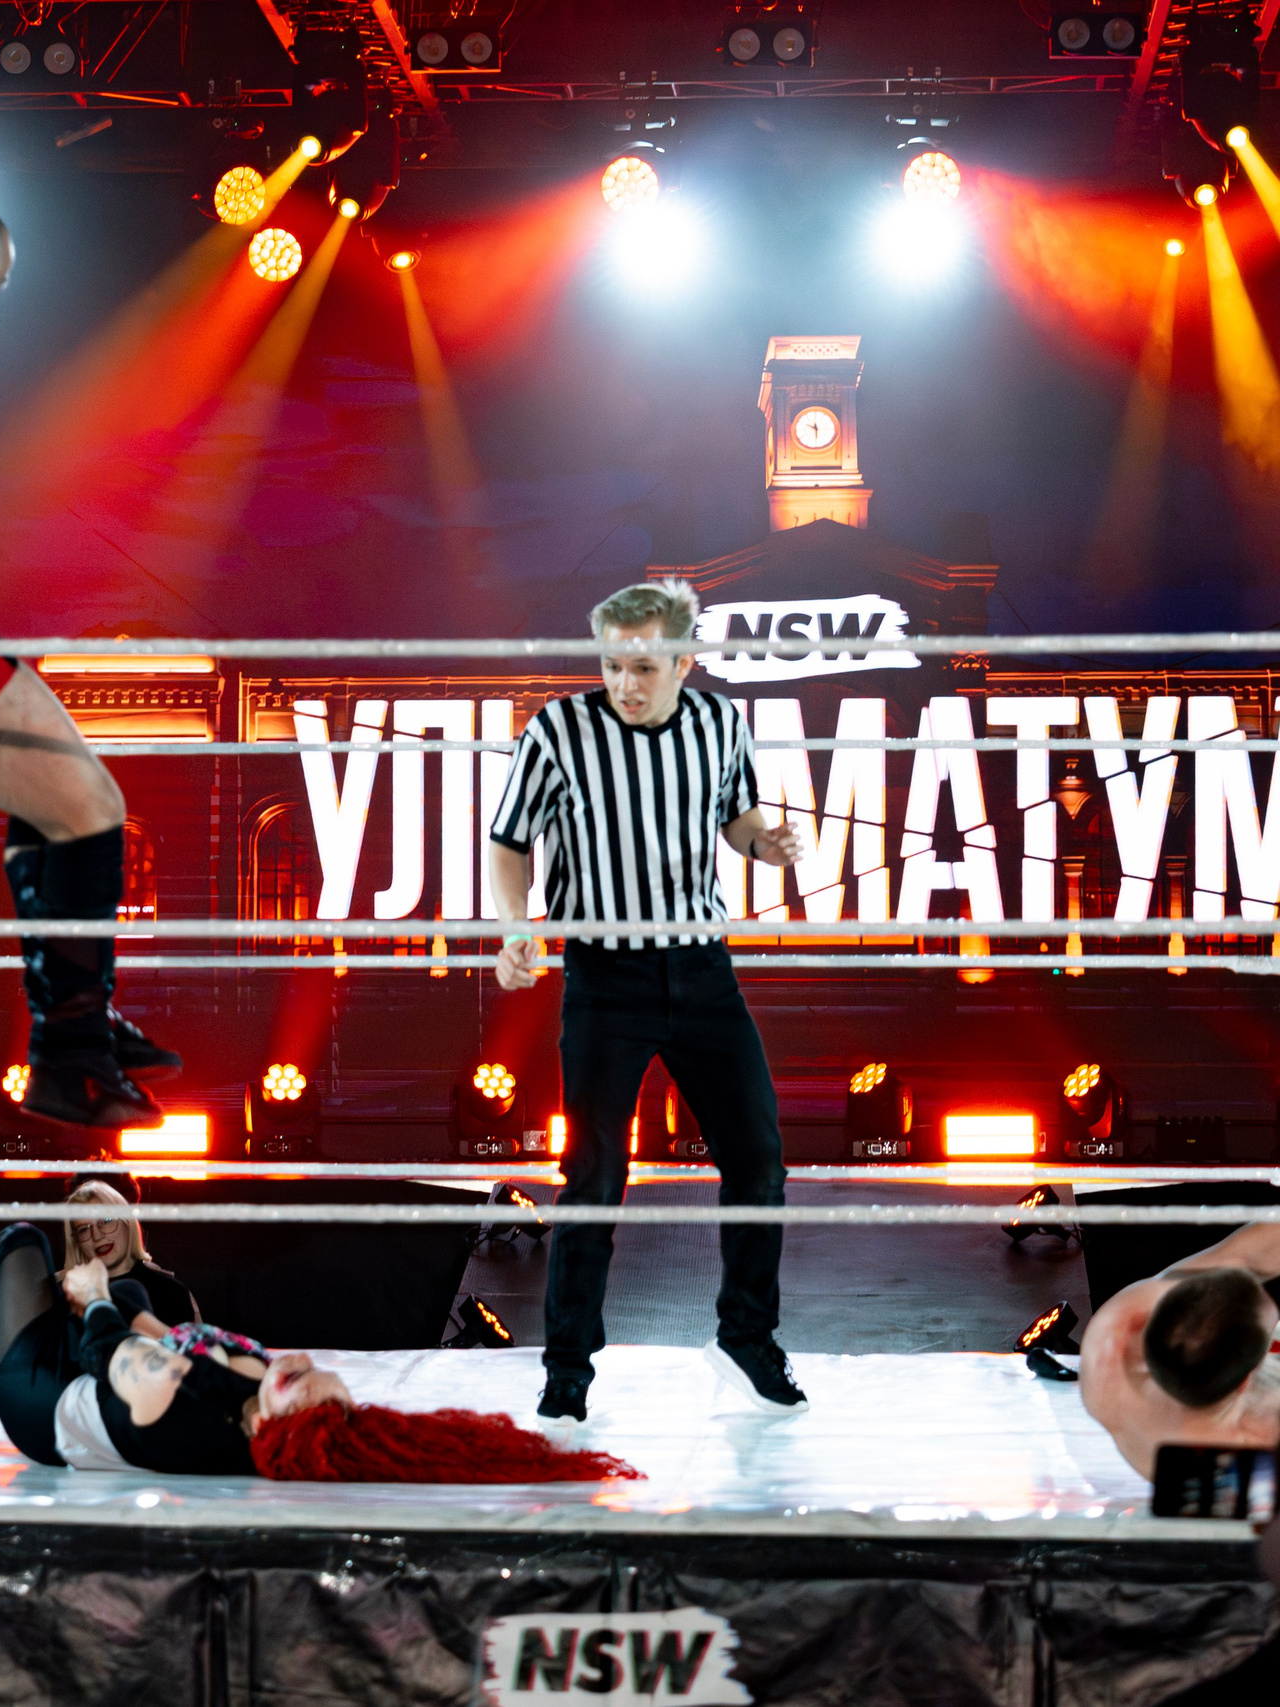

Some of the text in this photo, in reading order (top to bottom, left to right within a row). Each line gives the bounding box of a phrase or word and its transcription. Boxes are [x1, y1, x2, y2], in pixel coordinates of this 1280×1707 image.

[721, 613, 886, 661] NSW
[294, 697, 1280, 922] УЛМАТУМ
[513, 1627, 716, 1695] NSW
